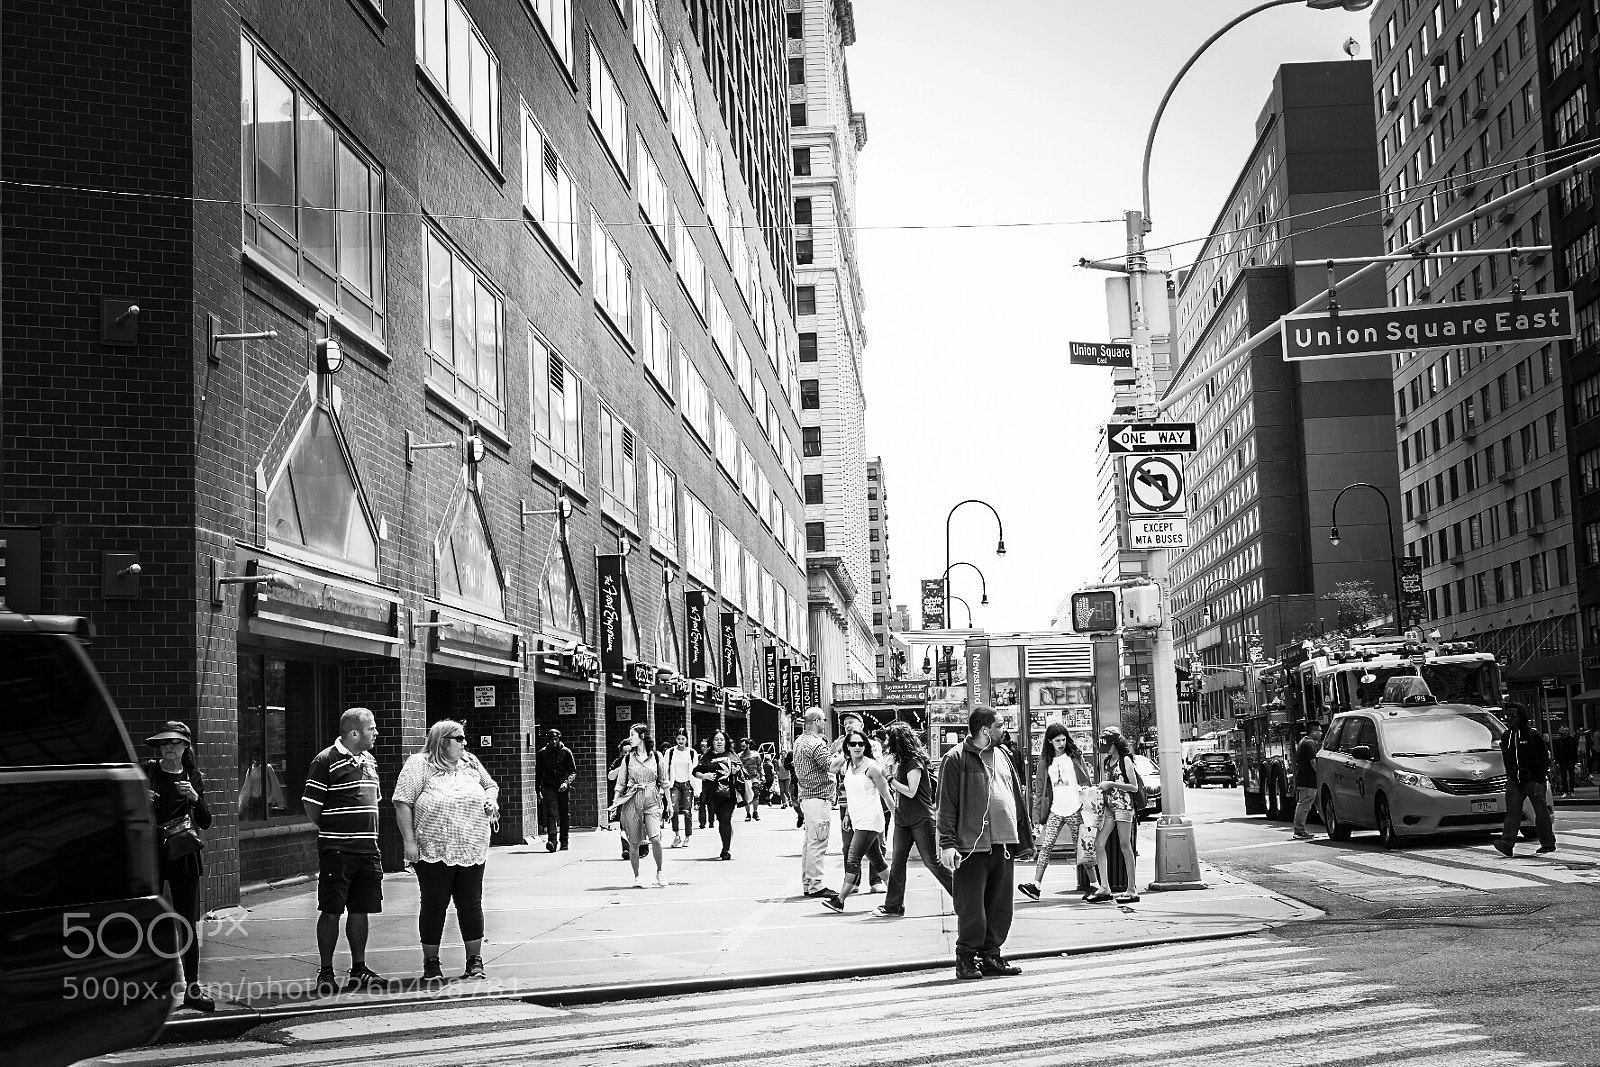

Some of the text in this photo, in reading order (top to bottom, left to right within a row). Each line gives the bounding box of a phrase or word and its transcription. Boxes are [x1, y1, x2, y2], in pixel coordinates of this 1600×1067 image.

[1295, 307, 1561, 348] Union Square East
[1072, 343, 1131, 360] Union Square
[1121, 431, 1185, 444] ONE WAY
[1143, 522, 1174, 533] EXCEPT
[1135, 534, 1183, 545] MTA BUSES
[602, 585, 618, 611] Food
[602, 610, 619, 653] Emporium
[767, 666, 775, 681] UPS
[972, 653, 982, 705] Newsstand
[767, 682, 776, 700] Store
[781, 664, 790, 708] SUBWAY
[803, 675, 811, 710] CHIPOTL
[1039, 686, 1091, 706] OPEN
